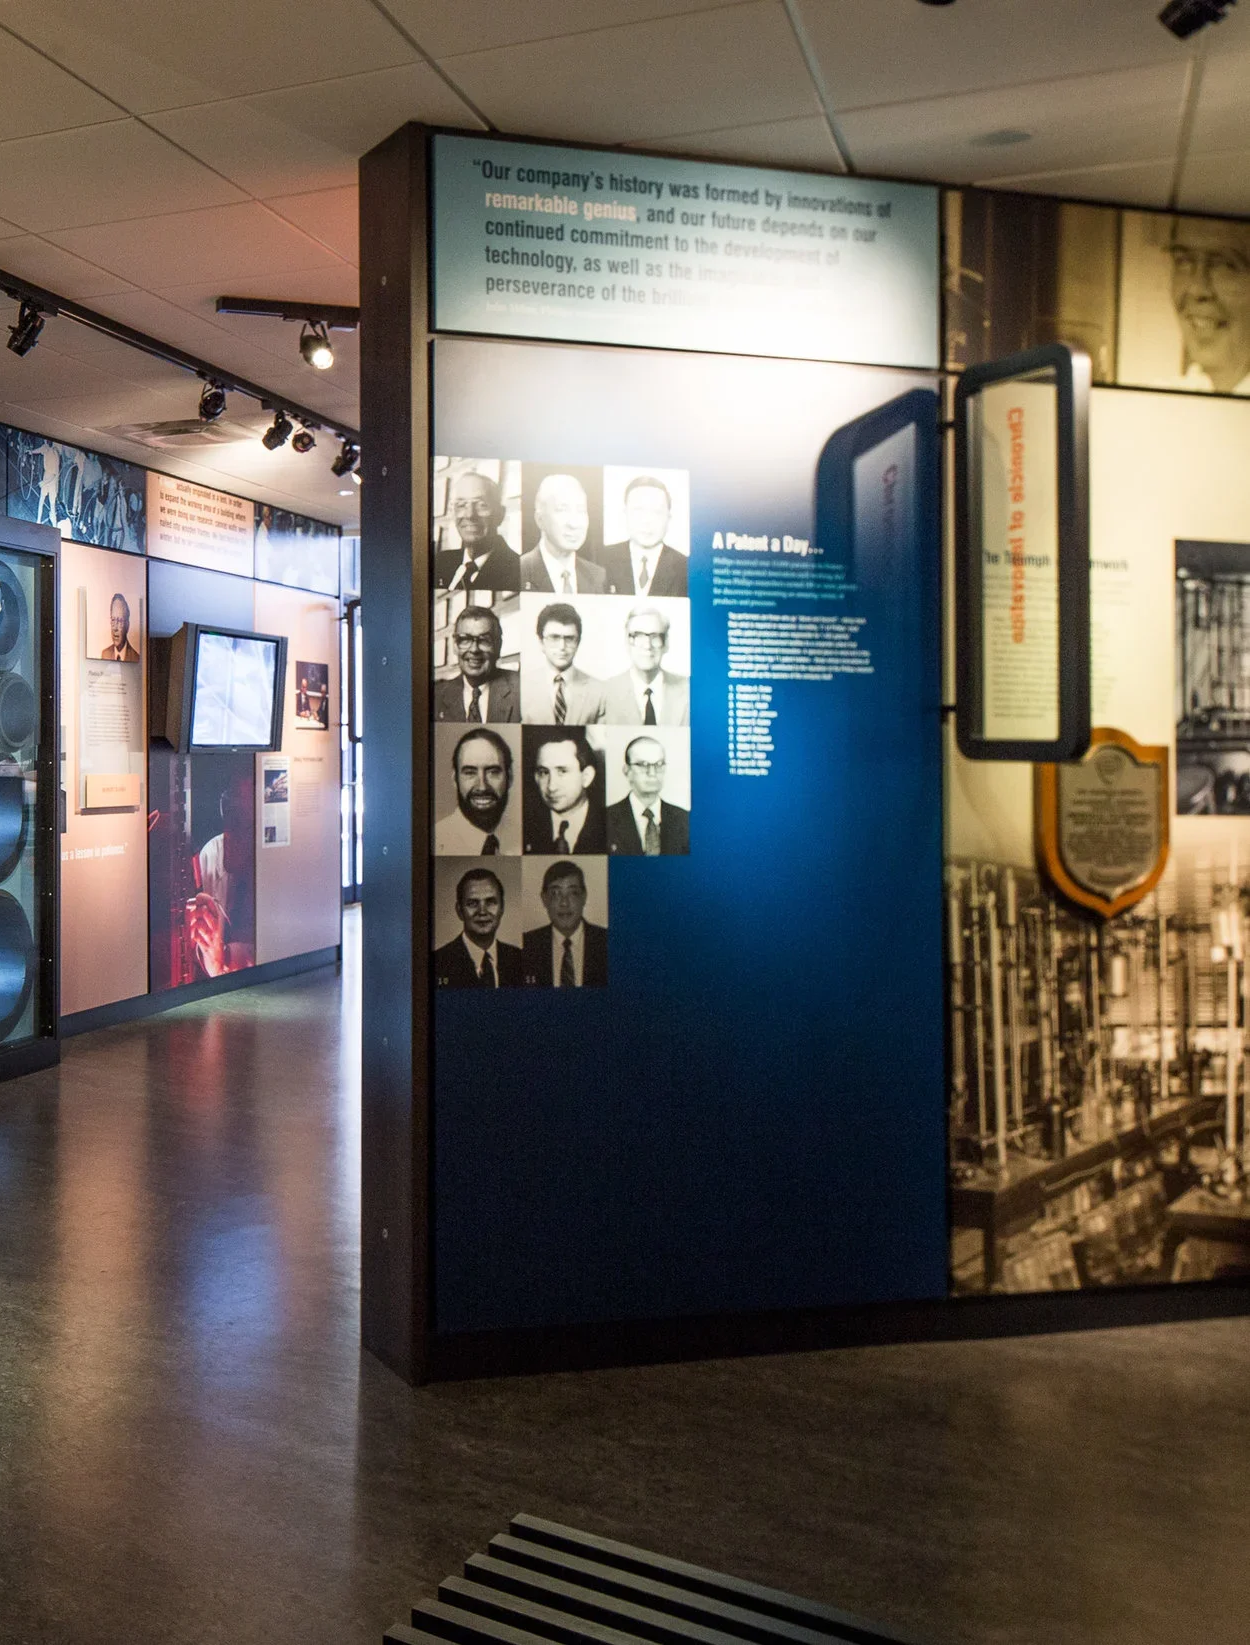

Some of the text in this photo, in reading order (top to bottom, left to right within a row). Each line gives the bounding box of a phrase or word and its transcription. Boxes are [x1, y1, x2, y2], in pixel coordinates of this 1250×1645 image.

[473, 159, 511, 182] “Our
[610, 173, 663, 199] history
[669, 184, 700, 200] was
[706, 184, 759, 205] formed
[765, 189, 782, 211] by
[787, 191, 873, 217] innovations
[877, 202, 892, 218] of
[485, 190, 877, 243] remarkable genius, and our future depends on our
[485, 217, 564, 242] continued
[570, 225, 669, 251] commitment
[674, 235, 689, 253] to
[694, 236, 718, 256] the
[724, 239, 820, 266] development
[485, 246, 577, 274] technology,
[583, 256, 601, 272] as
[607, 257, 640, 276] well
[645, 262, 663, 279] as
[668, 262, 692, 281] the
[485, 275, 595, 301] perseverance
[601, 286, 617, 302] of
[621, 285, 646, 305] the
[712, 531, 724, 550] A
[770, 537, 781, 552] a
